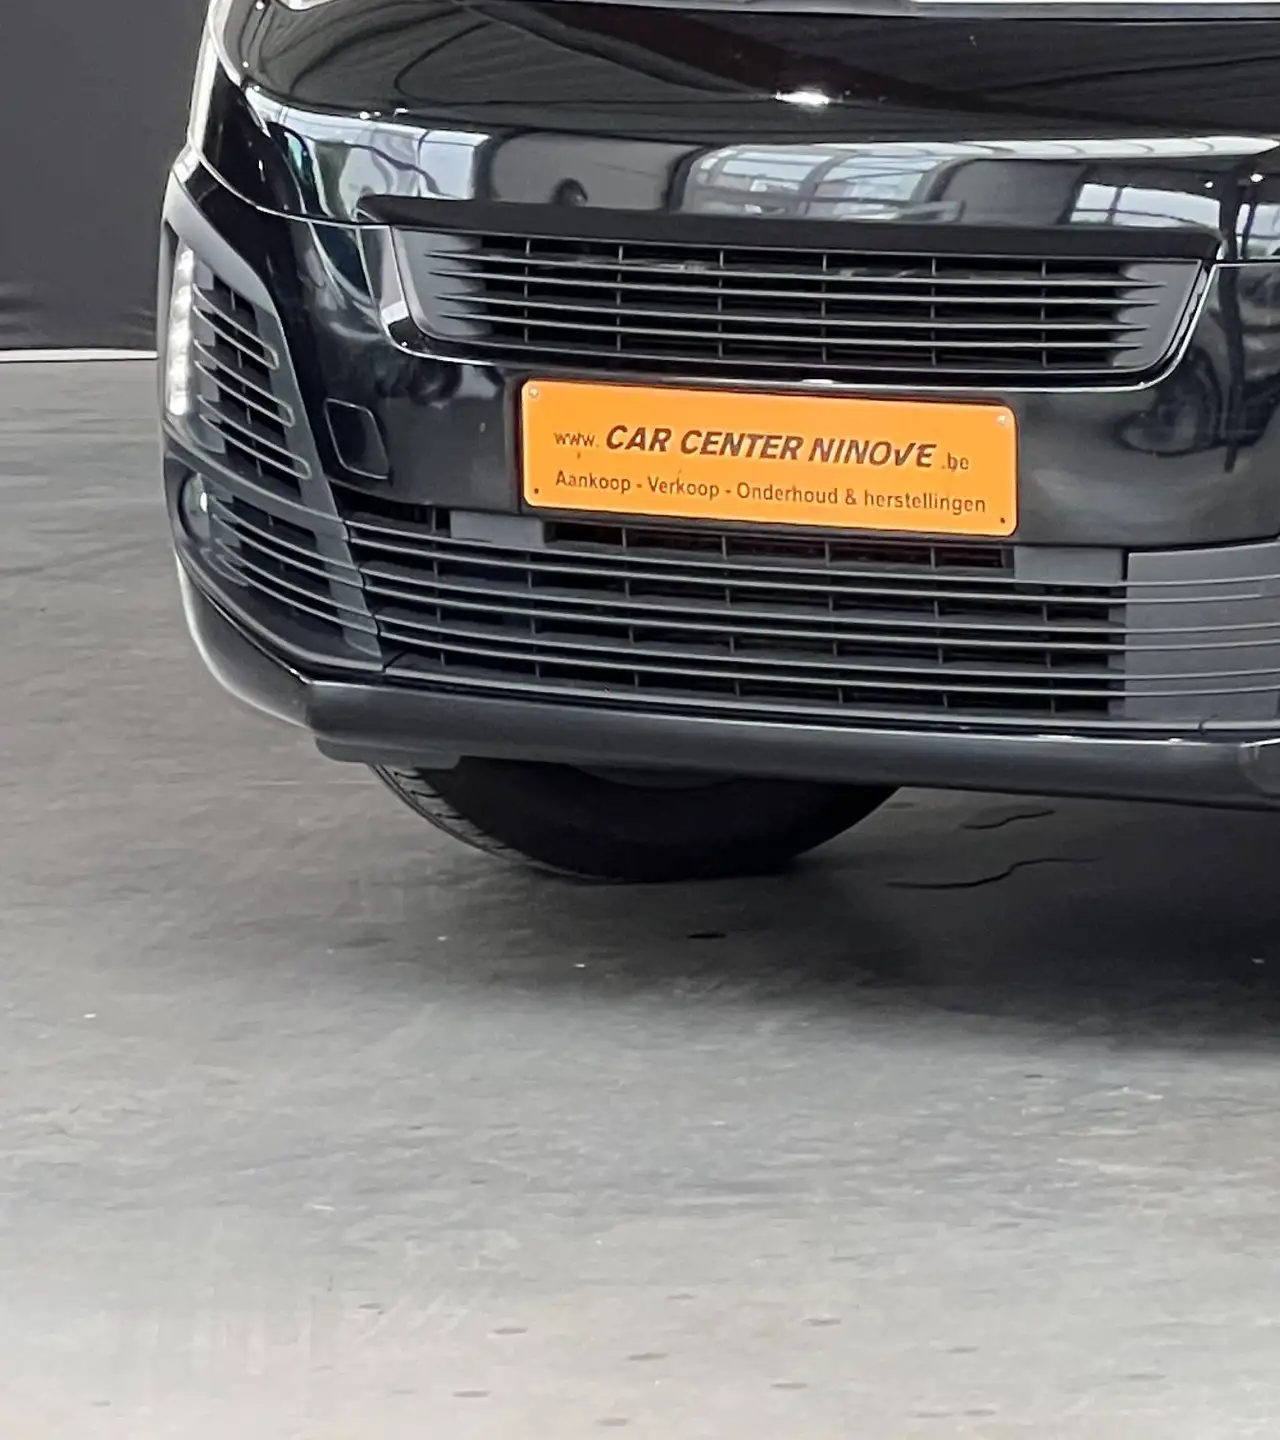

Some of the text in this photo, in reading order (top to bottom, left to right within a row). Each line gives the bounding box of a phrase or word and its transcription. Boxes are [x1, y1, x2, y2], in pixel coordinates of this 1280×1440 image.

[606, 424, 672, 452] CAR
[680, 429, 804, 461] CENTER
[807, 437, 938, 467] NINOVE
[555, 470, 631, 494] Aankoop
[647, 476, 720, 501] Verkoop
[736, 482, 838, 504] Onderhoud
[845, 488, 857, 505] &
[864, 490, 986, 516] herstellingen
